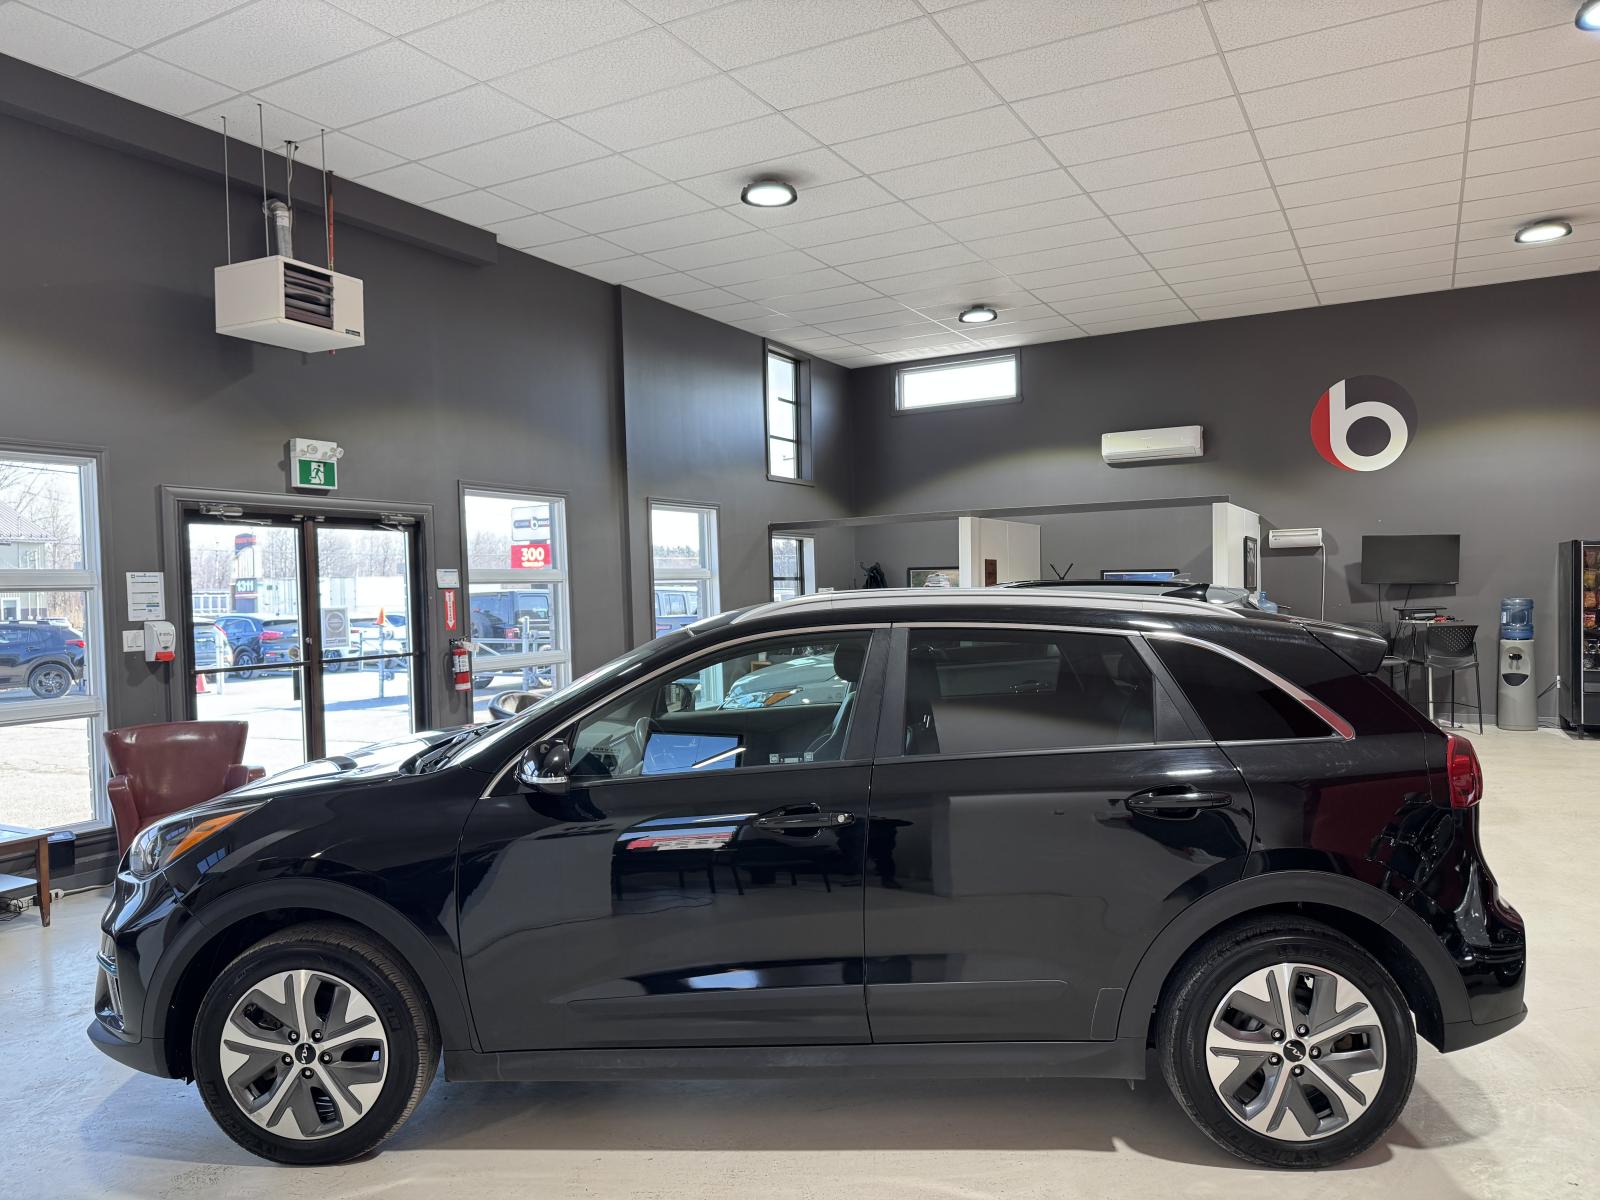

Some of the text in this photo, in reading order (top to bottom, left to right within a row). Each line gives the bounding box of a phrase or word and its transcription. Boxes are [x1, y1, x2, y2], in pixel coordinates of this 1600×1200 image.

[1329, 379, 1408, 471] b
[521, 547, 544, 561] 300
[236, 580, 253, 591] 1311
